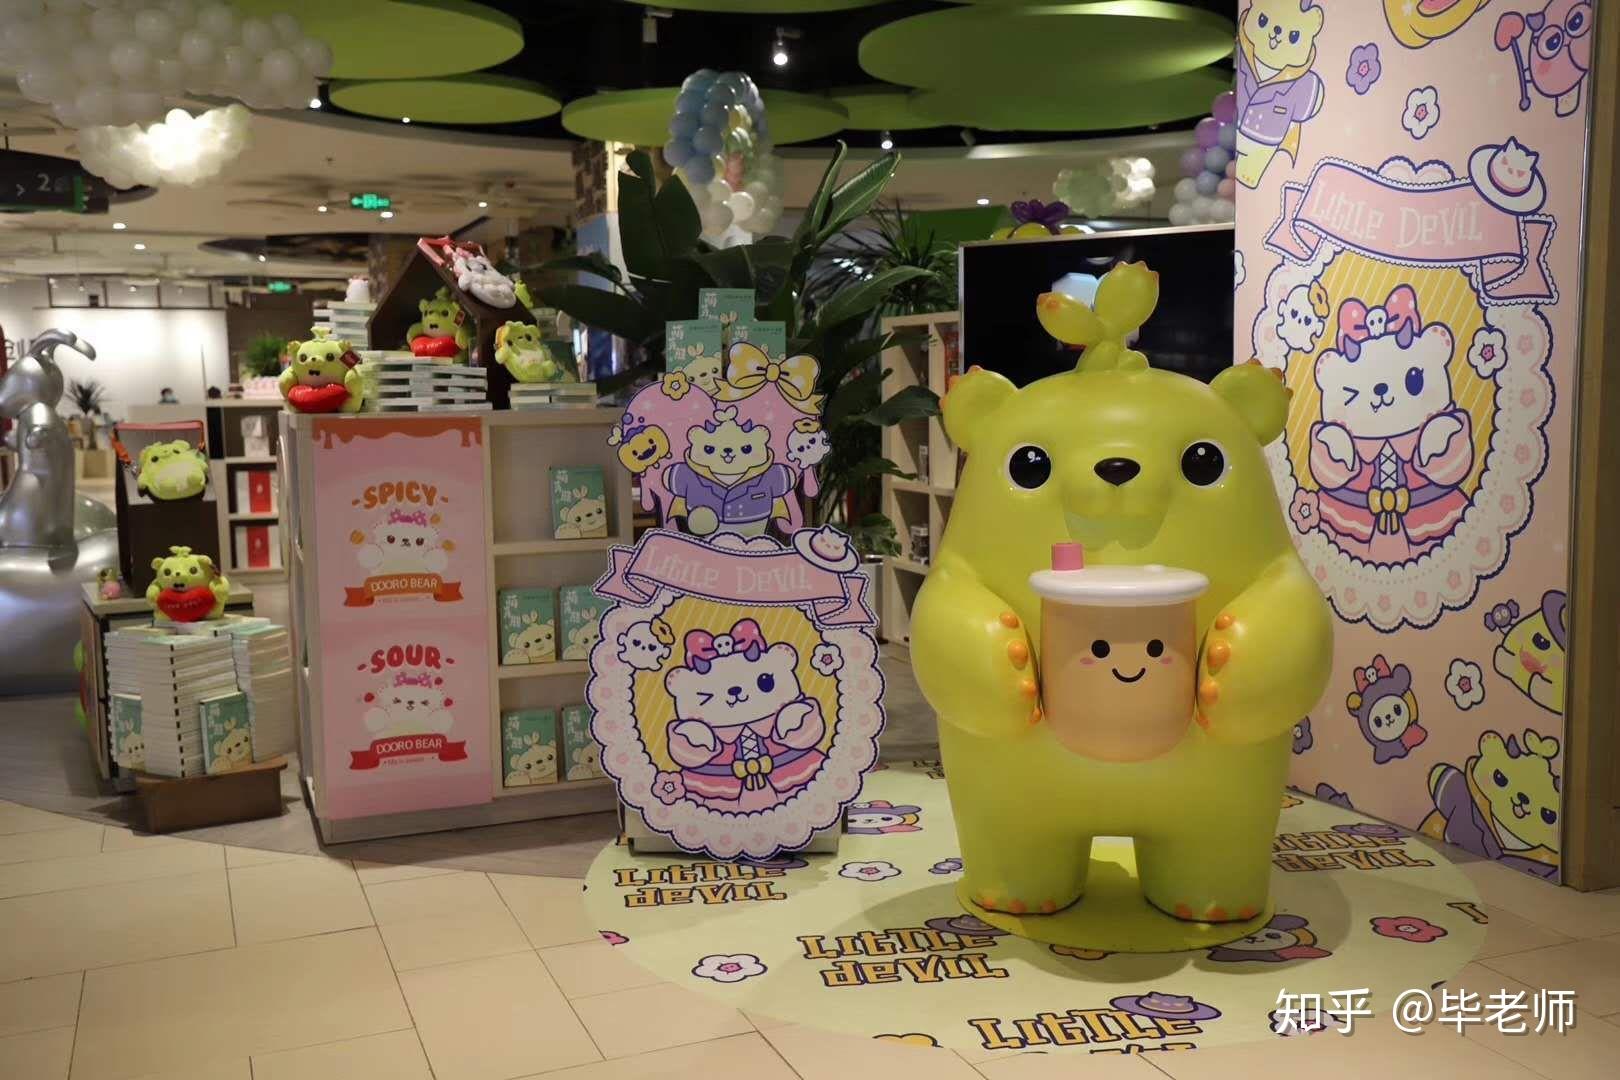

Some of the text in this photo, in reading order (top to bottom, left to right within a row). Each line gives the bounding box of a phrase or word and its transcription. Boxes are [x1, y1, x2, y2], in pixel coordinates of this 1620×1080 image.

[363, 480, 438, 510] SPICY
[371, 577, 438, 592] DOORO BEAR
[370, 644, 441, 674] SOUR
[376, 738, 442, 754] DOORO BEAR
